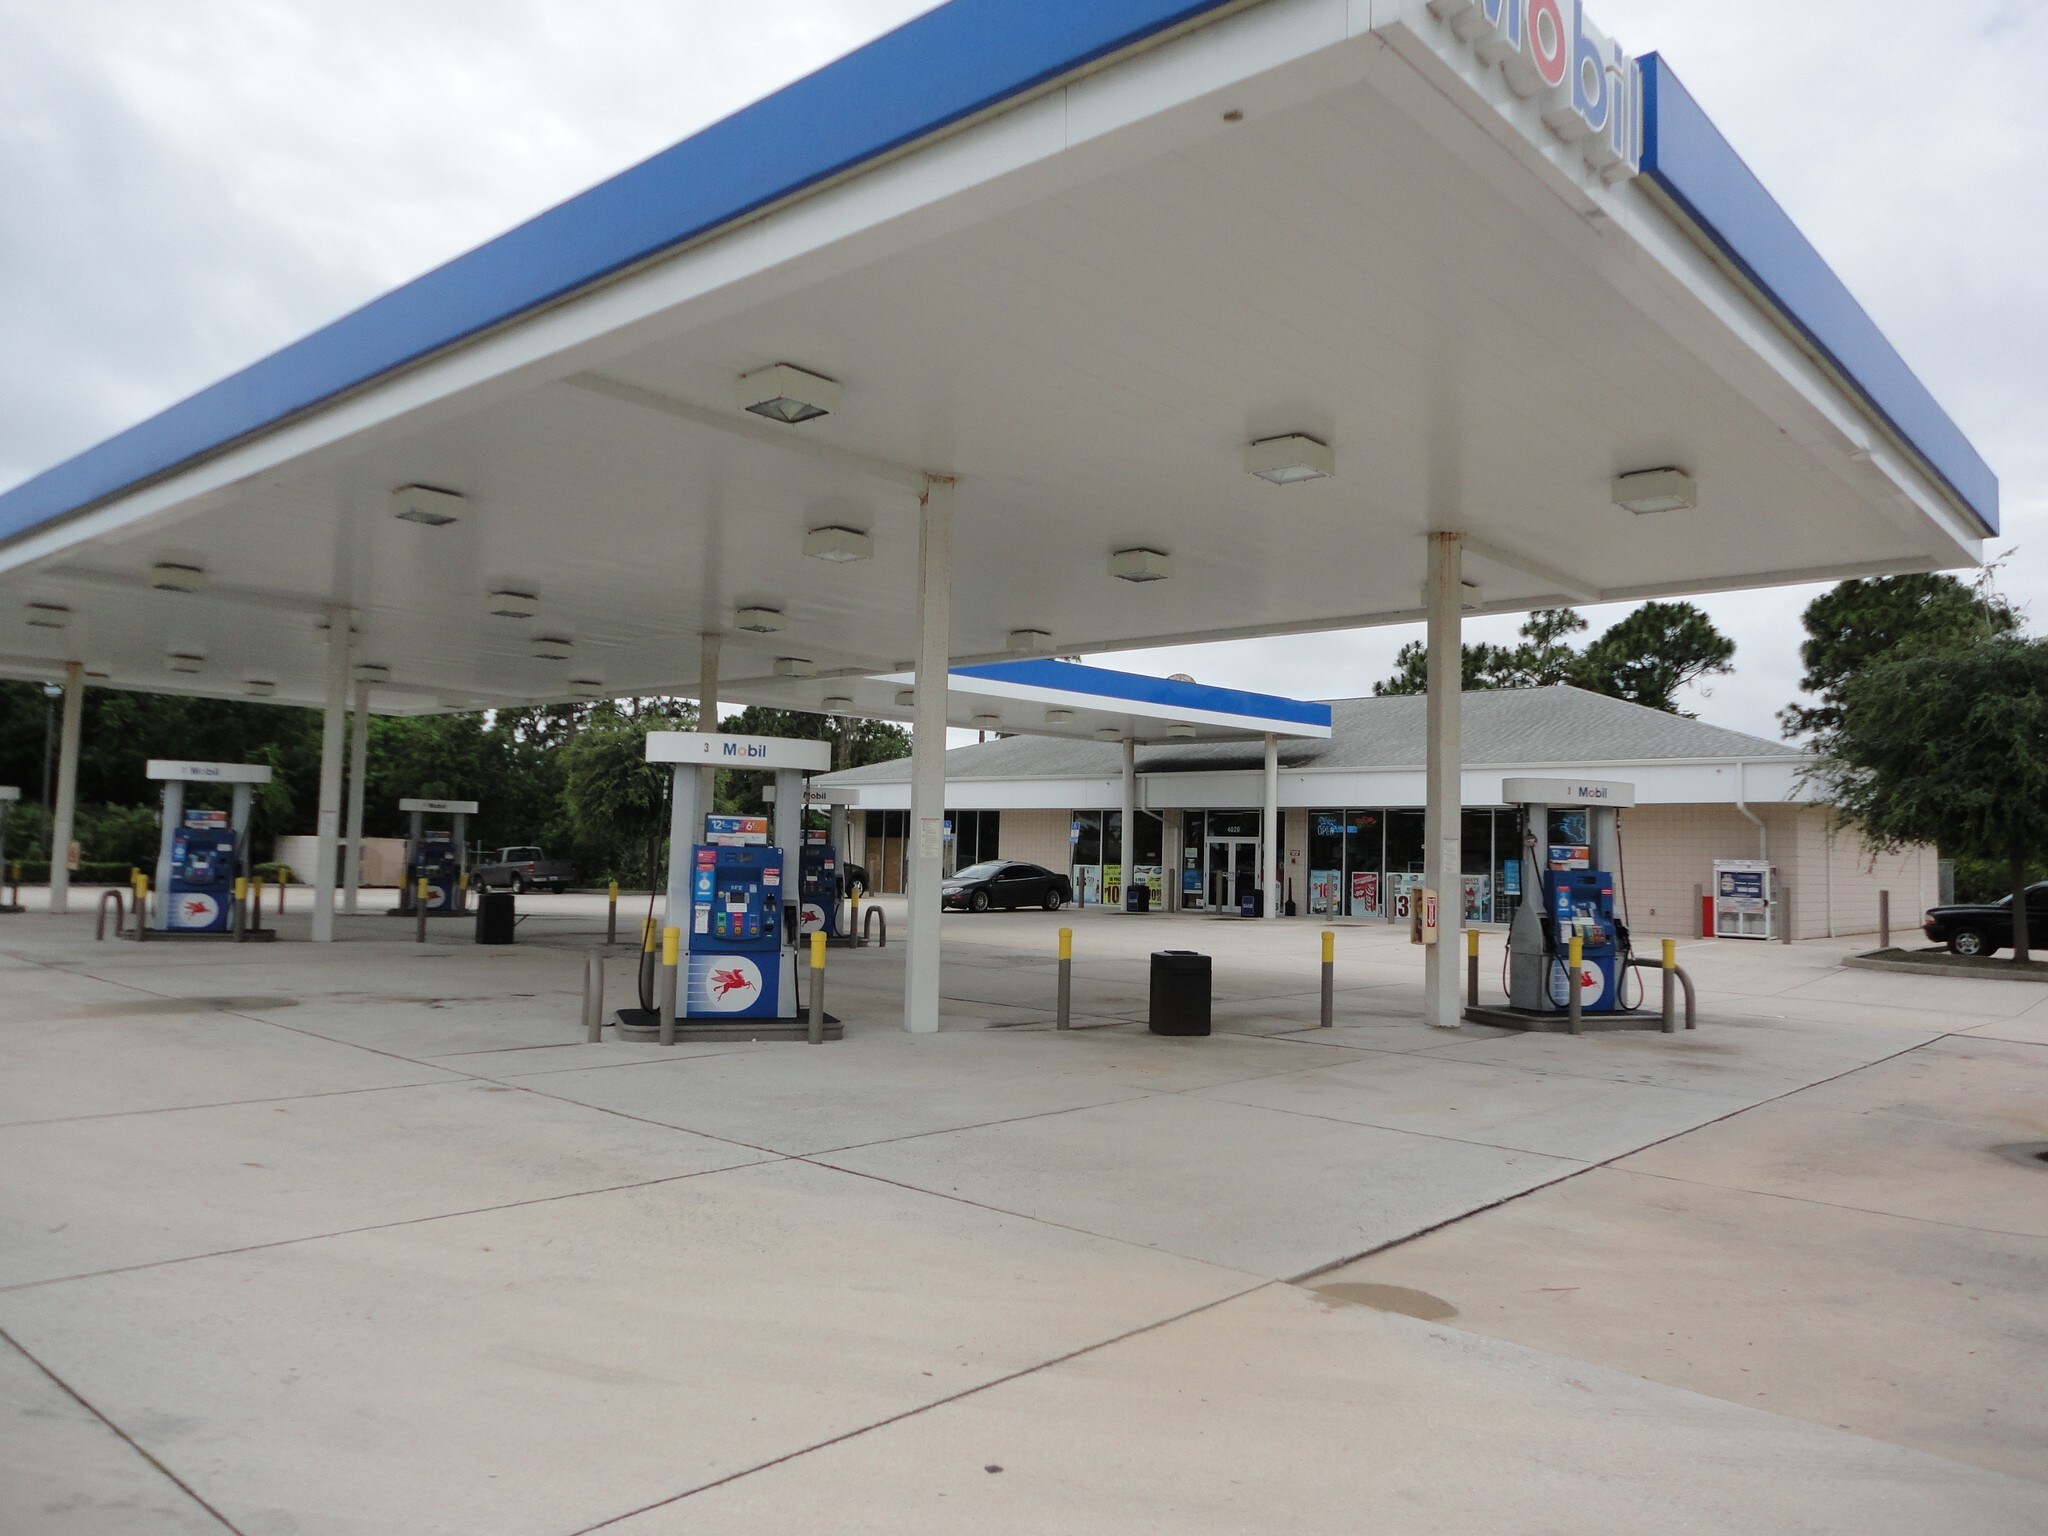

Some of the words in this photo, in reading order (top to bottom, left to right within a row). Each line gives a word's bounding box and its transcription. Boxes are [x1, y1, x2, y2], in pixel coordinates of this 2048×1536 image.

[704, 742, 709, 753] 3
[723, 742, 767, 757] Mobil
[1578, 786, 1608, 798] Mobil
